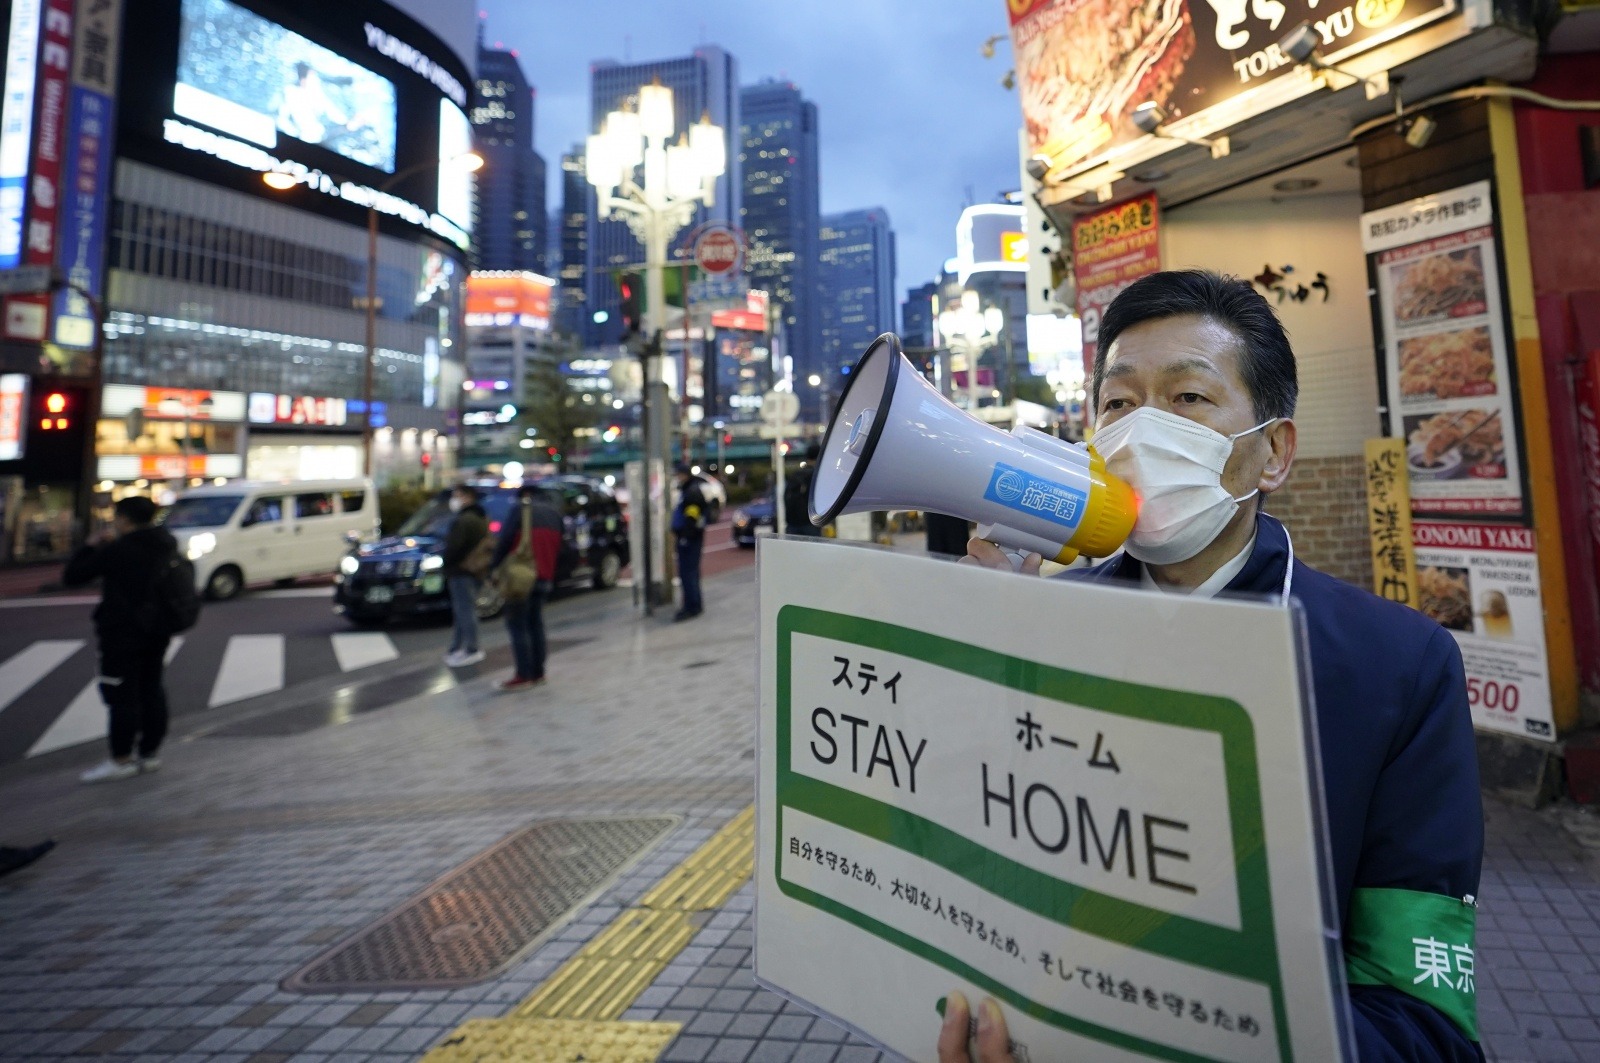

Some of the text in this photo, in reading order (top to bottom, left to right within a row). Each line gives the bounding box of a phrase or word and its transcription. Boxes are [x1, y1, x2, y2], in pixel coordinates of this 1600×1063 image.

[1370, 196, 1482, 238] 防犯カメラ作動中
[1021, 487, 1077, 520] 拡声器
[1484, 527, 1533, 549] YAKI
[832, 655, 903, 705] ステイ
[810, 706, 928, 794] STAY
[1015, 711, 1122, 775] ホーム
[981, 762, 1198, 896] HOME
[1412, 936, 1475, 993] 東京
